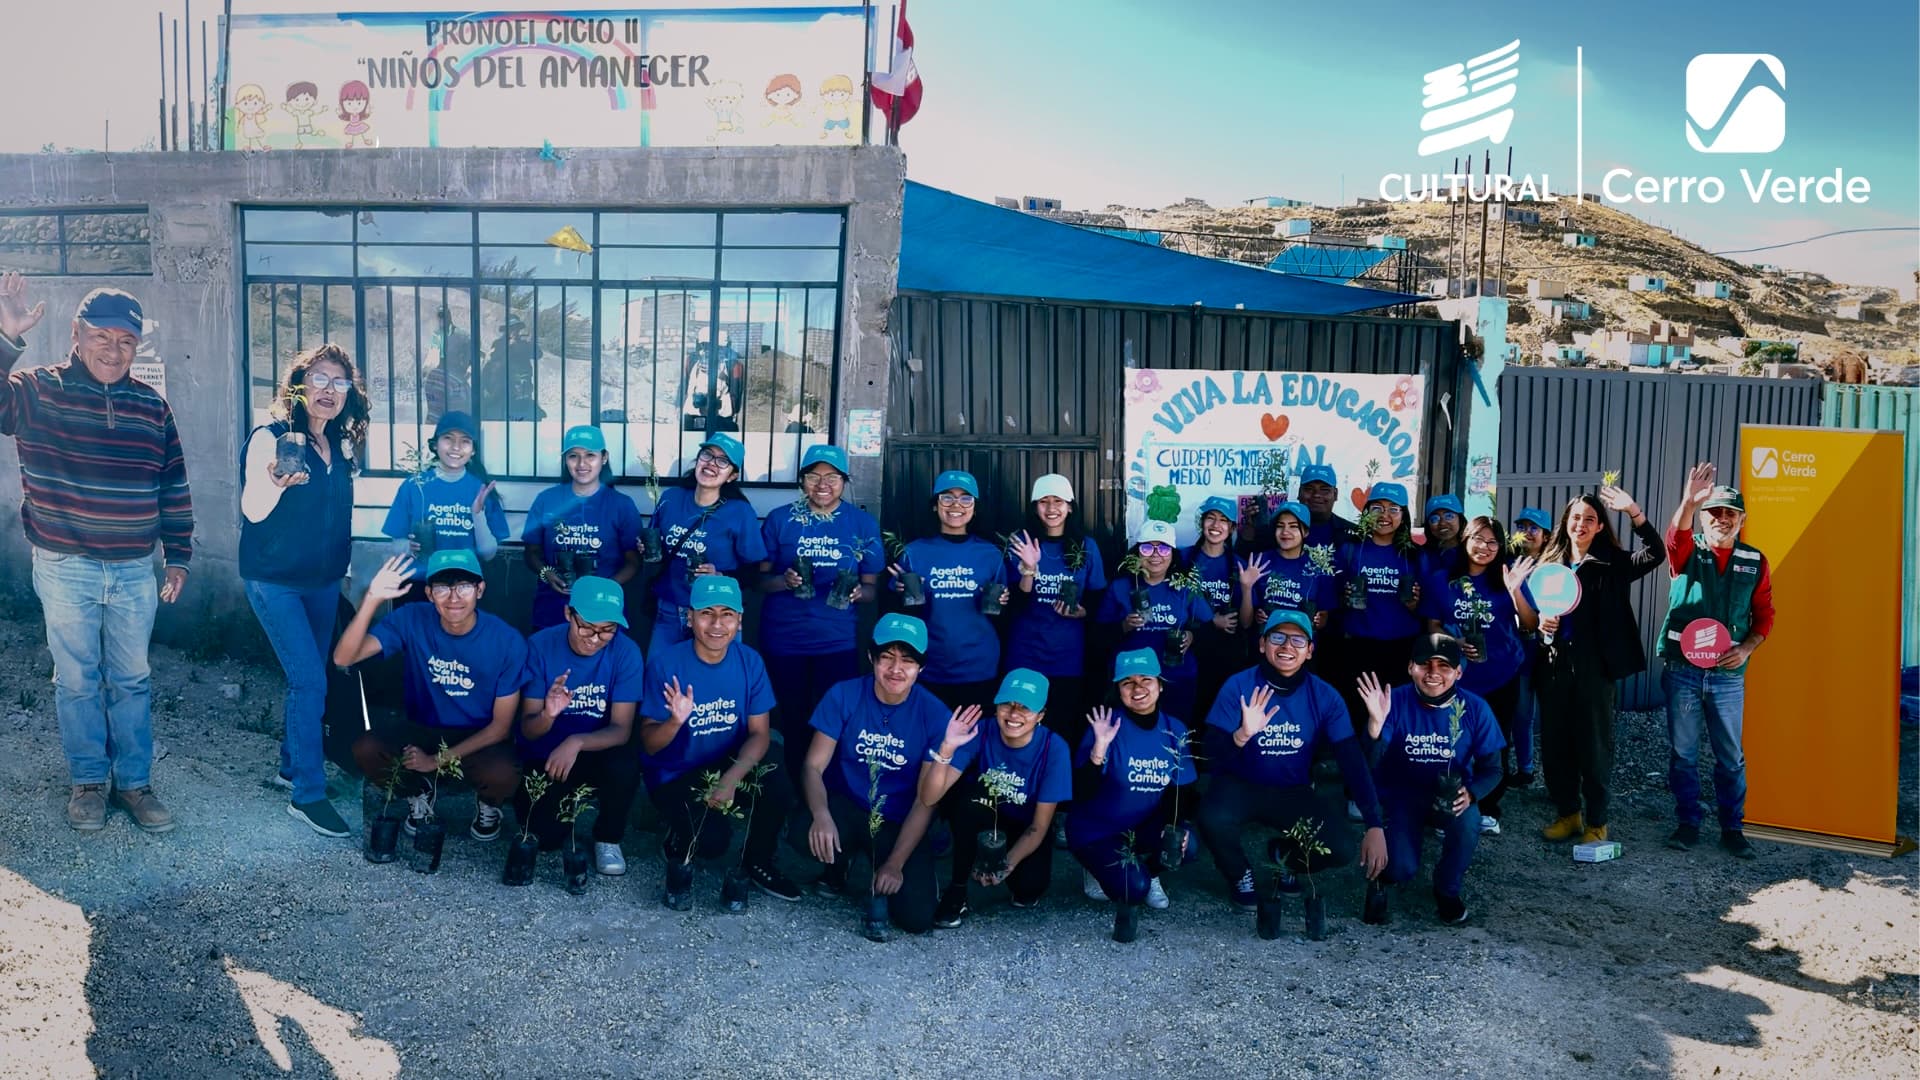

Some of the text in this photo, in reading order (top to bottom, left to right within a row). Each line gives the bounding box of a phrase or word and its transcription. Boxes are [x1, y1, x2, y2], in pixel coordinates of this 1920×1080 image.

[425, 19, 536, 46] PRONOEI
[545, 19, 615, 44] CICLO
[473, 57, 527, 88] DEL
[539, 55, 711, 88] AMANECER
[1153, 371, 1416, 479] VIVA LA EDUCACION
[1156, 448, 1235, 468] CUIDEMOS
[1782, 450, 1816, 464] Cerro
[1169, 468, 1211, 486] MEDIO
[1782, 464, 1817, 478] Verde
[555, 533, 602, 548] Cambio
[798, 535, 839, 548] Agentes
[797, 546, 842, 560] Cambio
[930, 565, 974, 579] Agentes
[1361, 566, 1399, 577] Agentes
[929, 578, 978, 591] Cambio
[1201, 580, 1230, 591] gentes
[1367, 575, 1400, 588] ambio
[1685, 651, 1720, 659] CULTURA
[568, 695, 607, 712] ambio
[691, 697, 736, 716] Agentes
[688, 711, 738, 728] Cambio
[858, 729, 905, 749] Agentes
[1257, 735, 1304, 749] Cambio
[1405, 732, 1449, 747] Agentes
[855, 743, 907, 765] Cambio
[1404, 744, 1454, 758] Cambio
[1128, 756, 1169, 772] Agentes
[1127, 770, 1171, 786] Cambio
